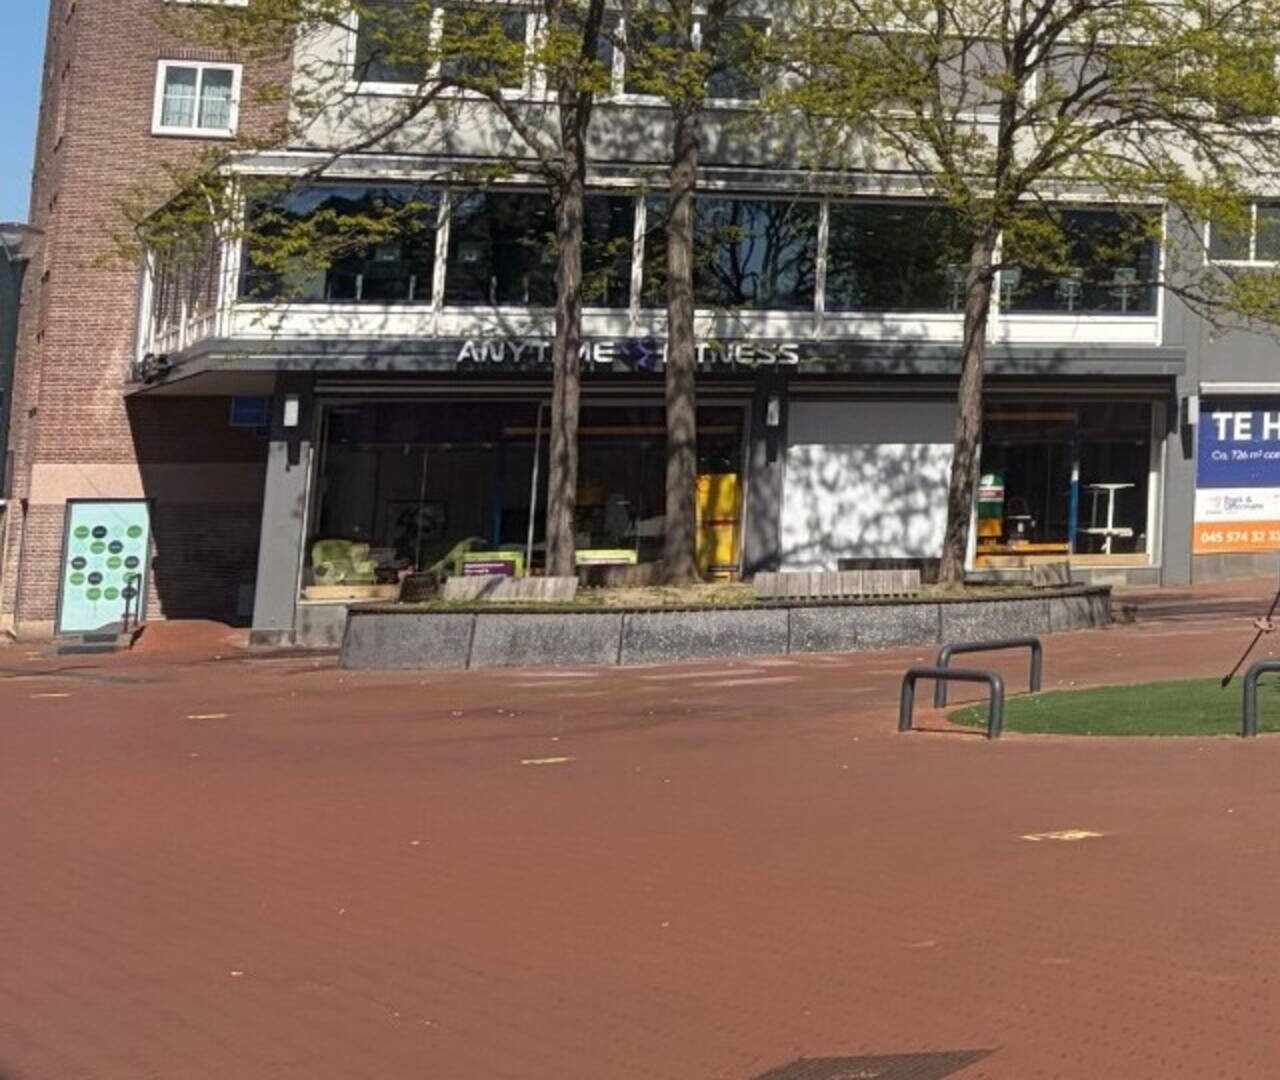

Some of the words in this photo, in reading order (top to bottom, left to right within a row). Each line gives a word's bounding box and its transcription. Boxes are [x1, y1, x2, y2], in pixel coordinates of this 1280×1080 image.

[456, 340, 615, 364] ANYTME
[662, 342, 799, 366] TNESS
[1212, 411, 1252, 441] TE
